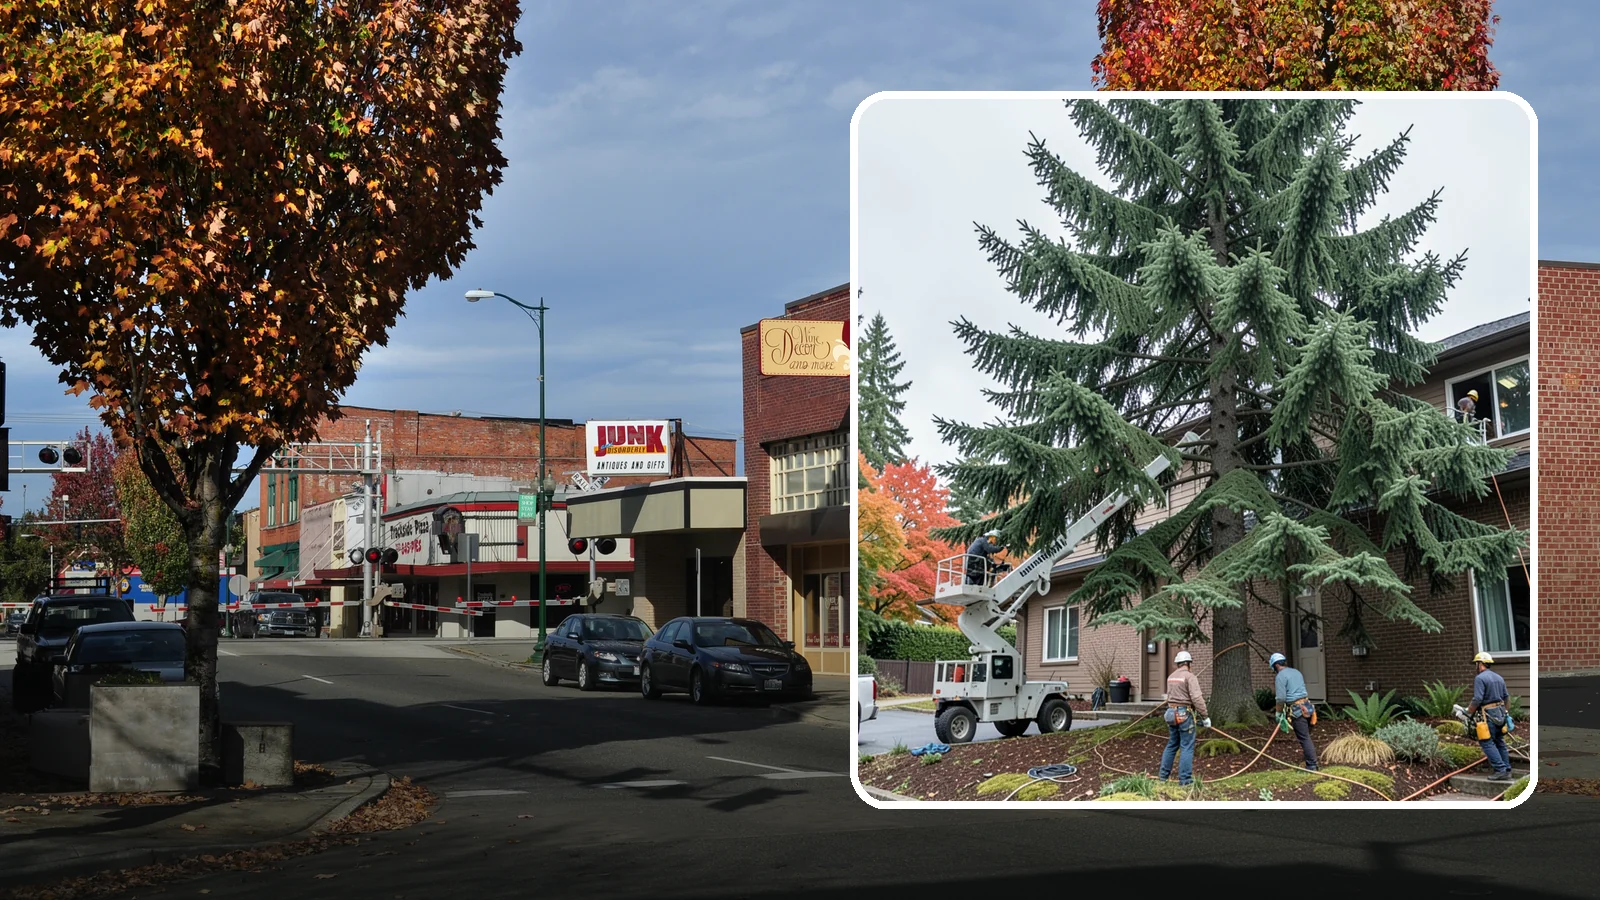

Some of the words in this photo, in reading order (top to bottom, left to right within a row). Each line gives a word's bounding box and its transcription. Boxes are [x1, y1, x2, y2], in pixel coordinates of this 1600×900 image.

[595, 425, 665, 457] JUNK
[607, 446, 646, 454] DISORDERLY
[596, 461, 628, 470] ANTIQUES
[631, 461, 643, 470] AND
[647, 460, 665, 469] GIFTS
[390, 521, 413, 540] Trackside
[414, 519, 429, 535] Pizza
